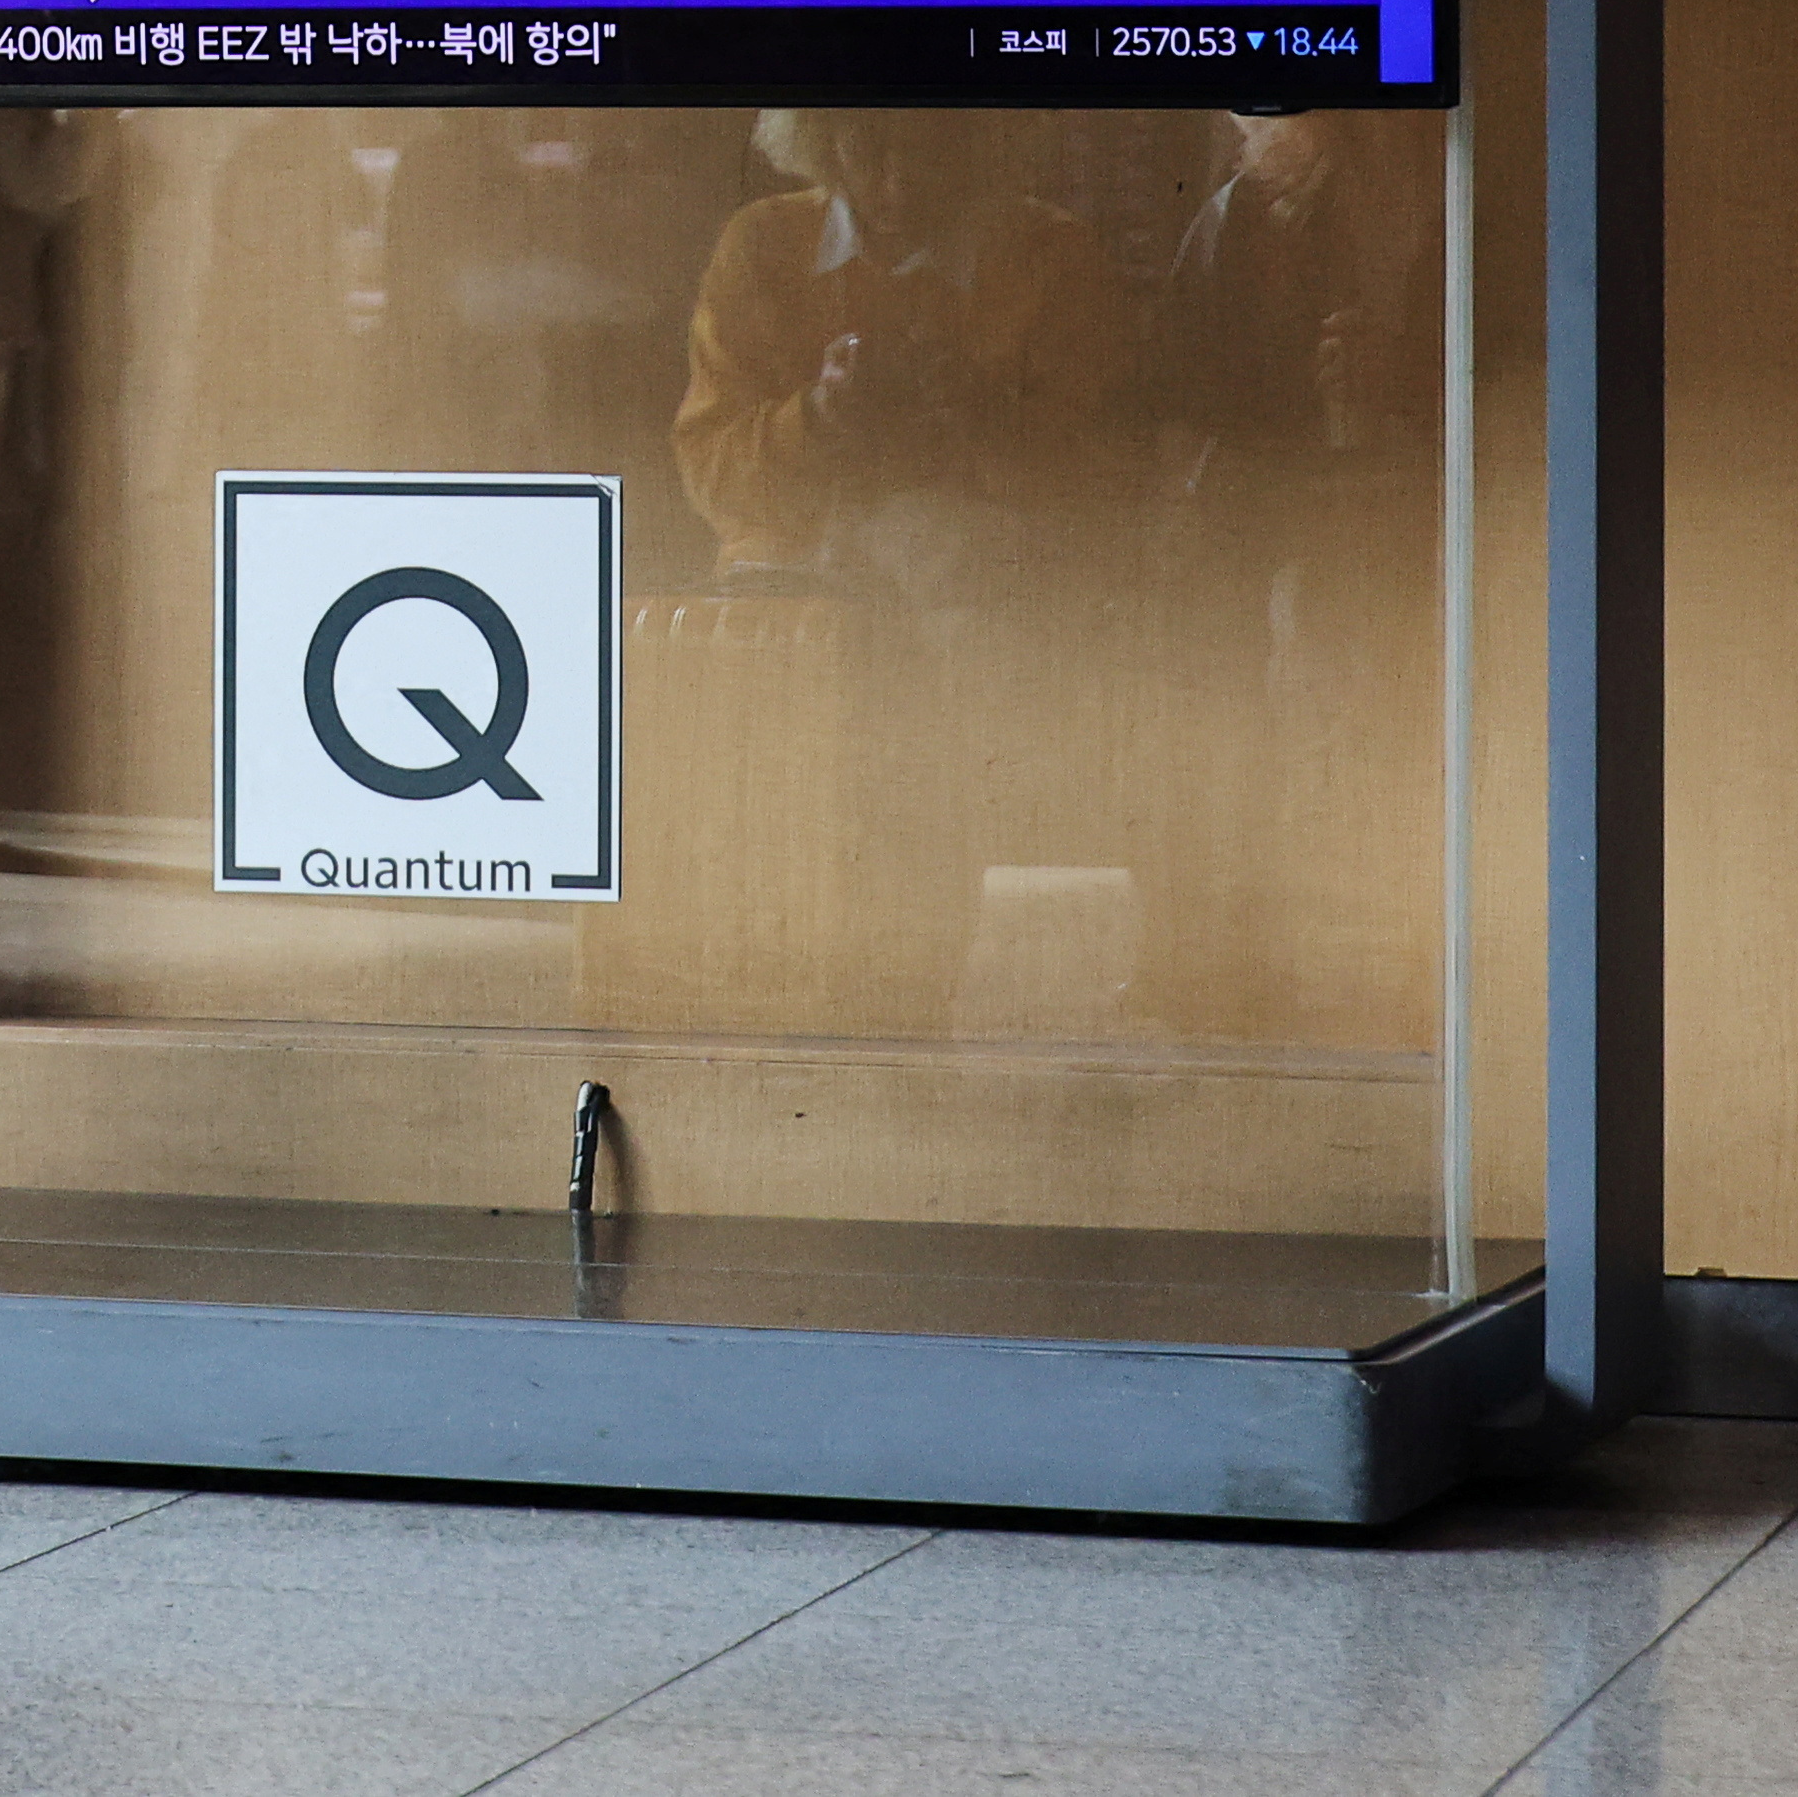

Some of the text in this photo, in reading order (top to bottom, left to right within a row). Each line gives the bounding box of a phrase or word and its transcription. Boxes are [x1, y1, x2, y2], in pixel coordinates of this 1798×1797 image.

[114, 22, 185, 65] 비행
[198, 25, 270, 62] EEZ
[280, 22, 316, 65] 밖
[526, 21, 617, 65] 항의"
[999, 26, 1359, 57] 코스피 2570.53 18.44
[303, 566, 545, 802] Q
[301, 847, 532, 892] Quantum
